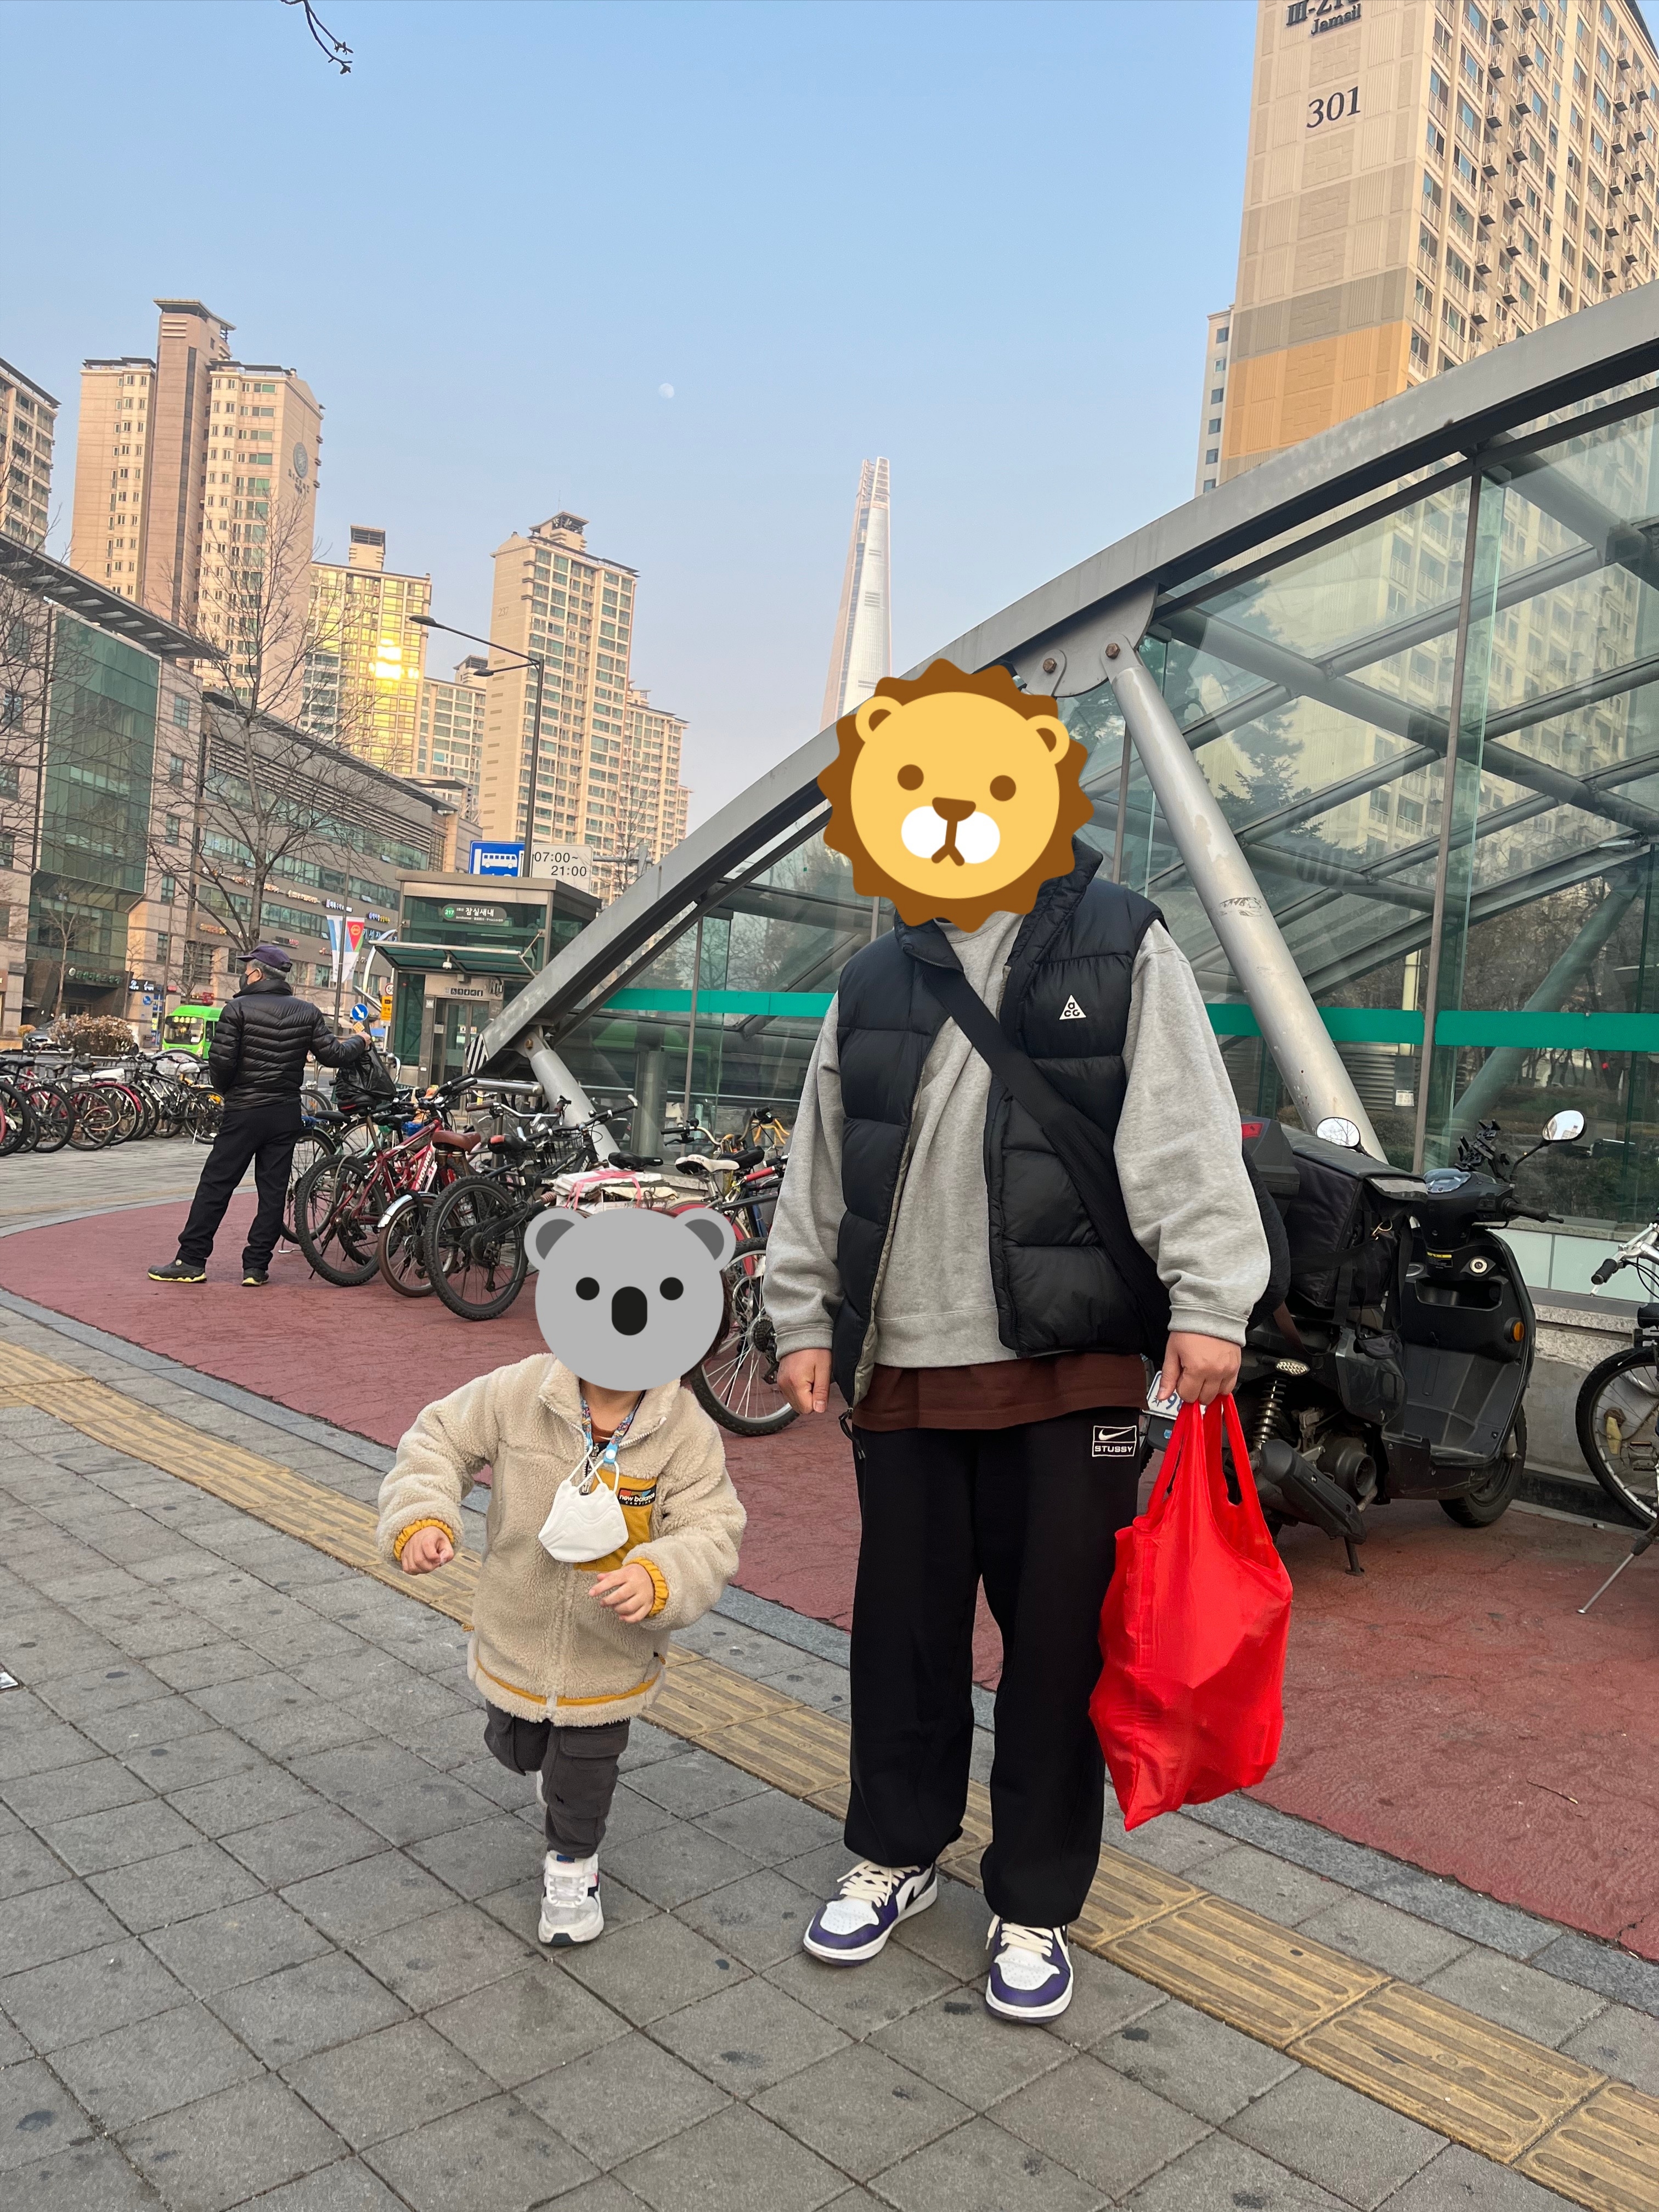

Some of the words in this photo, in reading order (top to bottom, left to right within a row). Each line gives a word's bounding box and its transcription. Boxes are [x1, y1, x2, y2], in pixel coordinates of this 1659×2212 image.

[1311, 3, 1361, 36] Jamsil
[1306, 86, 1361, 128] 301
[534, 851, 578, 862] 07:00~
[551, 865, 587, 877] 21:00
[465, 907, 494, 917] 잠실새내
[417, 1150, 432, 1185] HOUND
[634, 1492, 655, 1502] balance
